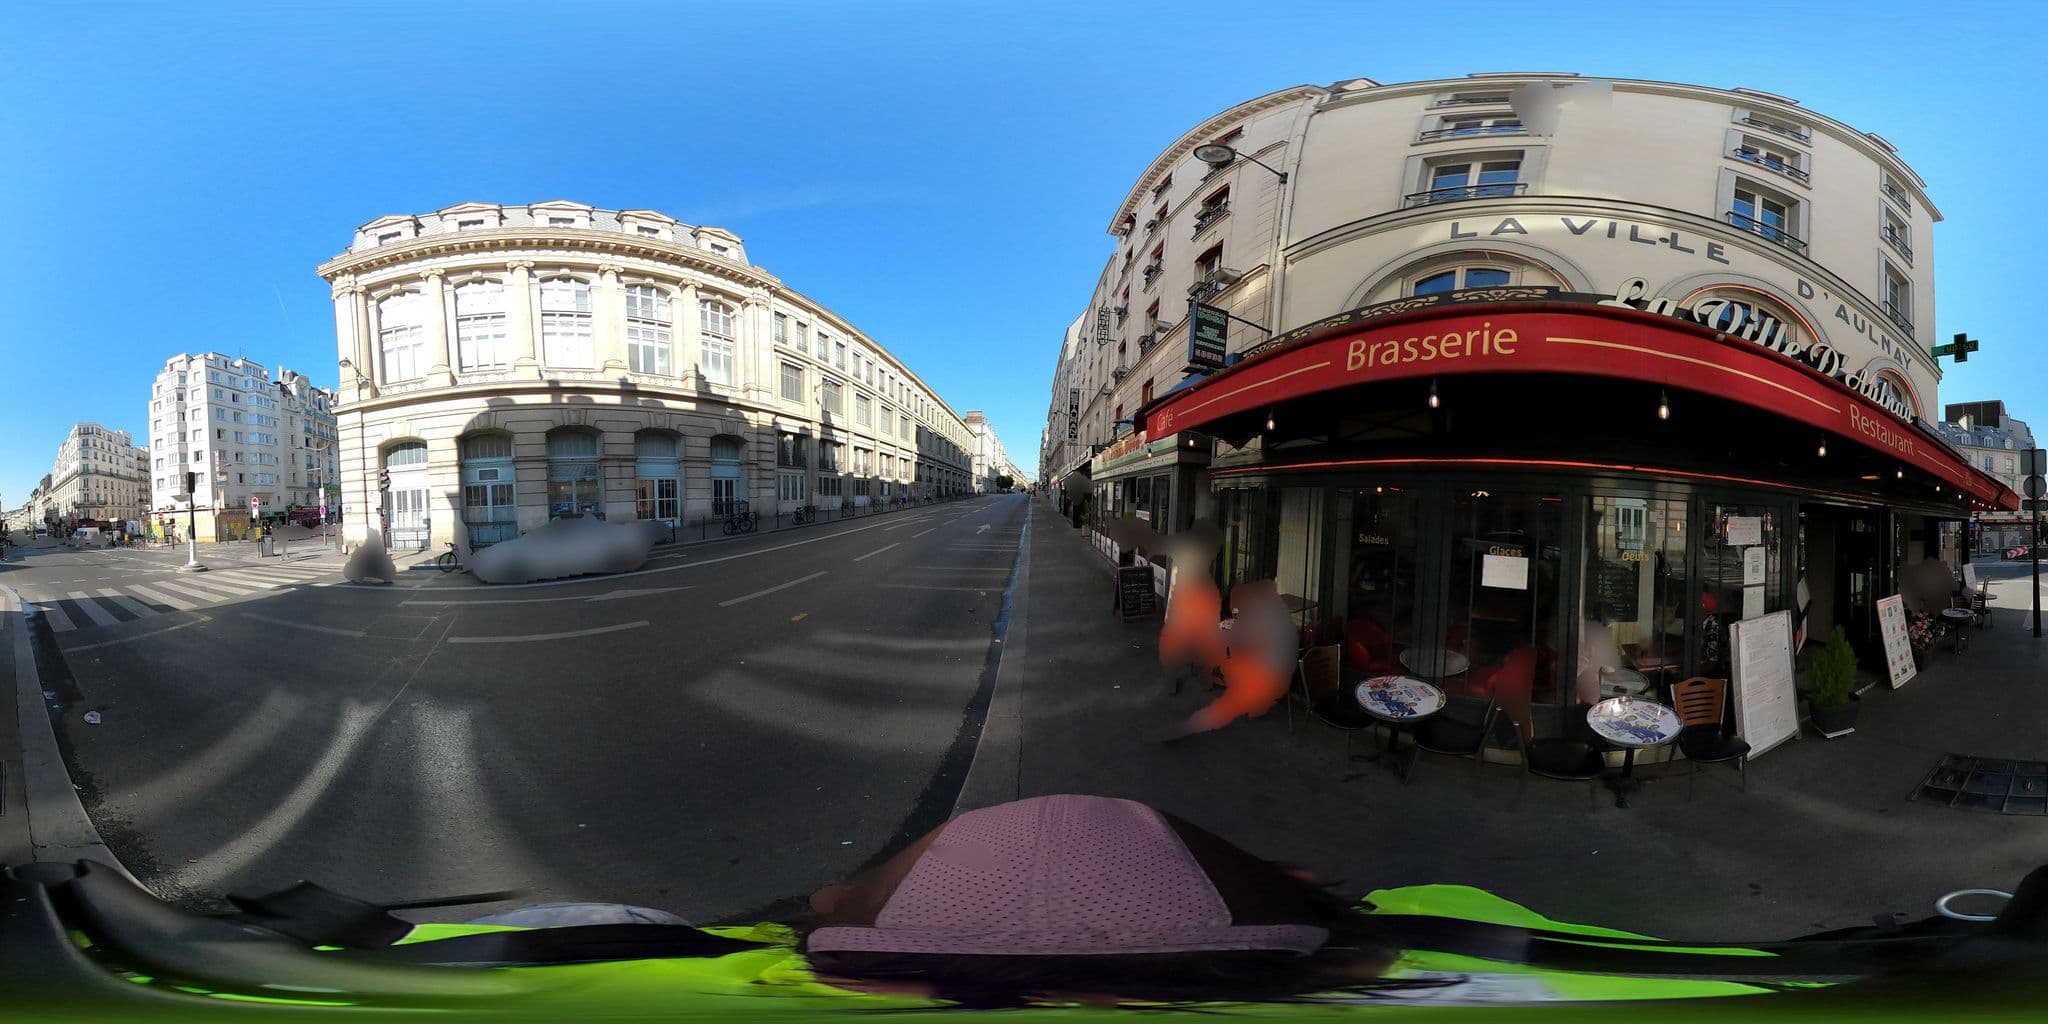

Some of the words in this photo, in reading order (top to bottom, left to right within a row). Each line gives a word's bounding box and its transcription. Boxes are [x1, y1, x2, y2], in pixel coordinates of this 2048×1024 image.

[1450, 217, 1529, 239] LA
[1561, 217, 1730, 265] VILLE
[1797, 278, 1912, 370] D'AULNAY
[1598, 276, 1680, 317] La
[1692, 298, 1803, 364] Ville
[1346, 321, 1518, 372] Brasserie
[1156, 407, 1174, 432] Café
[1849, 403, 1914, 456] Restaurant
[1358, 533, 1390, 545] Salades
[1488, 545, 1522, 557] Glaces
